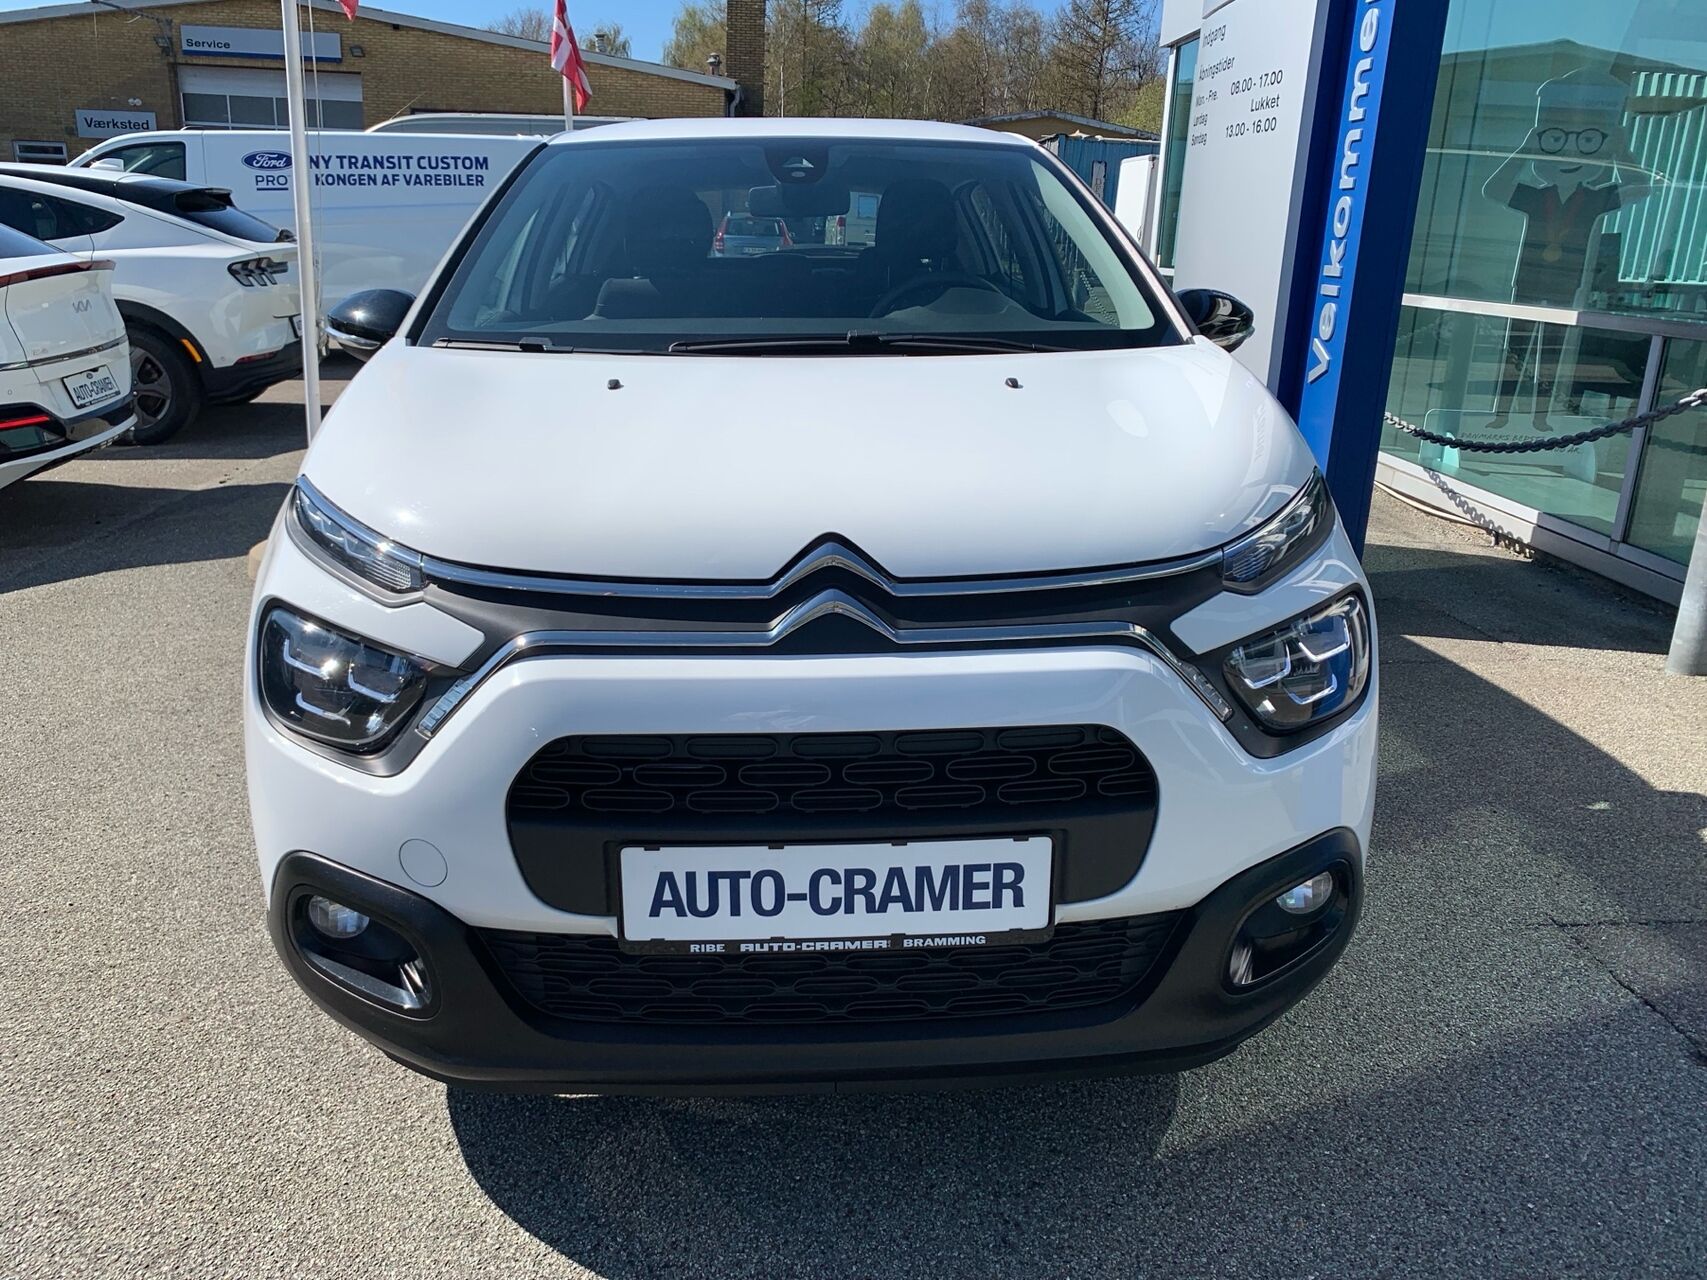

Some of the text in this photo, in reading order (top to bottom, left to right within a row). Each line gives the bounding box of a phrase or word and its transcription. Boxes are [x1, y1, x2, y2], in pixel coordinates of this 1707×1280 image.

[185, 37, 231, 50] Service
[1202, 24, 1227, 48] Indgang
[1199, 55, 1236, 82] Åbningstider
[1230, 76, 1253, 96] 08.00
[1259, 69, 1283, 89] 17.00
[1250, 93, 1280, 113] Lukket
[84, 116, 150, 131] Værksted
[1225, 121, 1246, 139] 13.00
[1252, 116, 1277, 134] 16.00
[251, 152, 289, 168] Ford
[309, 155, 489, 170] NY TRANSIT CUSTOM
[255, 174, 288, 186] PRO
[315, 173, 485, 187] KONGEN AF VAREBILER
[1306, 0, 1380, 384] Velkomme
[72, 376, 115, 402] AUTO-CRAMER
[648, 861, 1026, 918] AUTO-CRAMER
[690, 935, 986, 953] RIBE AUTO-CRAMER BRAMMING
